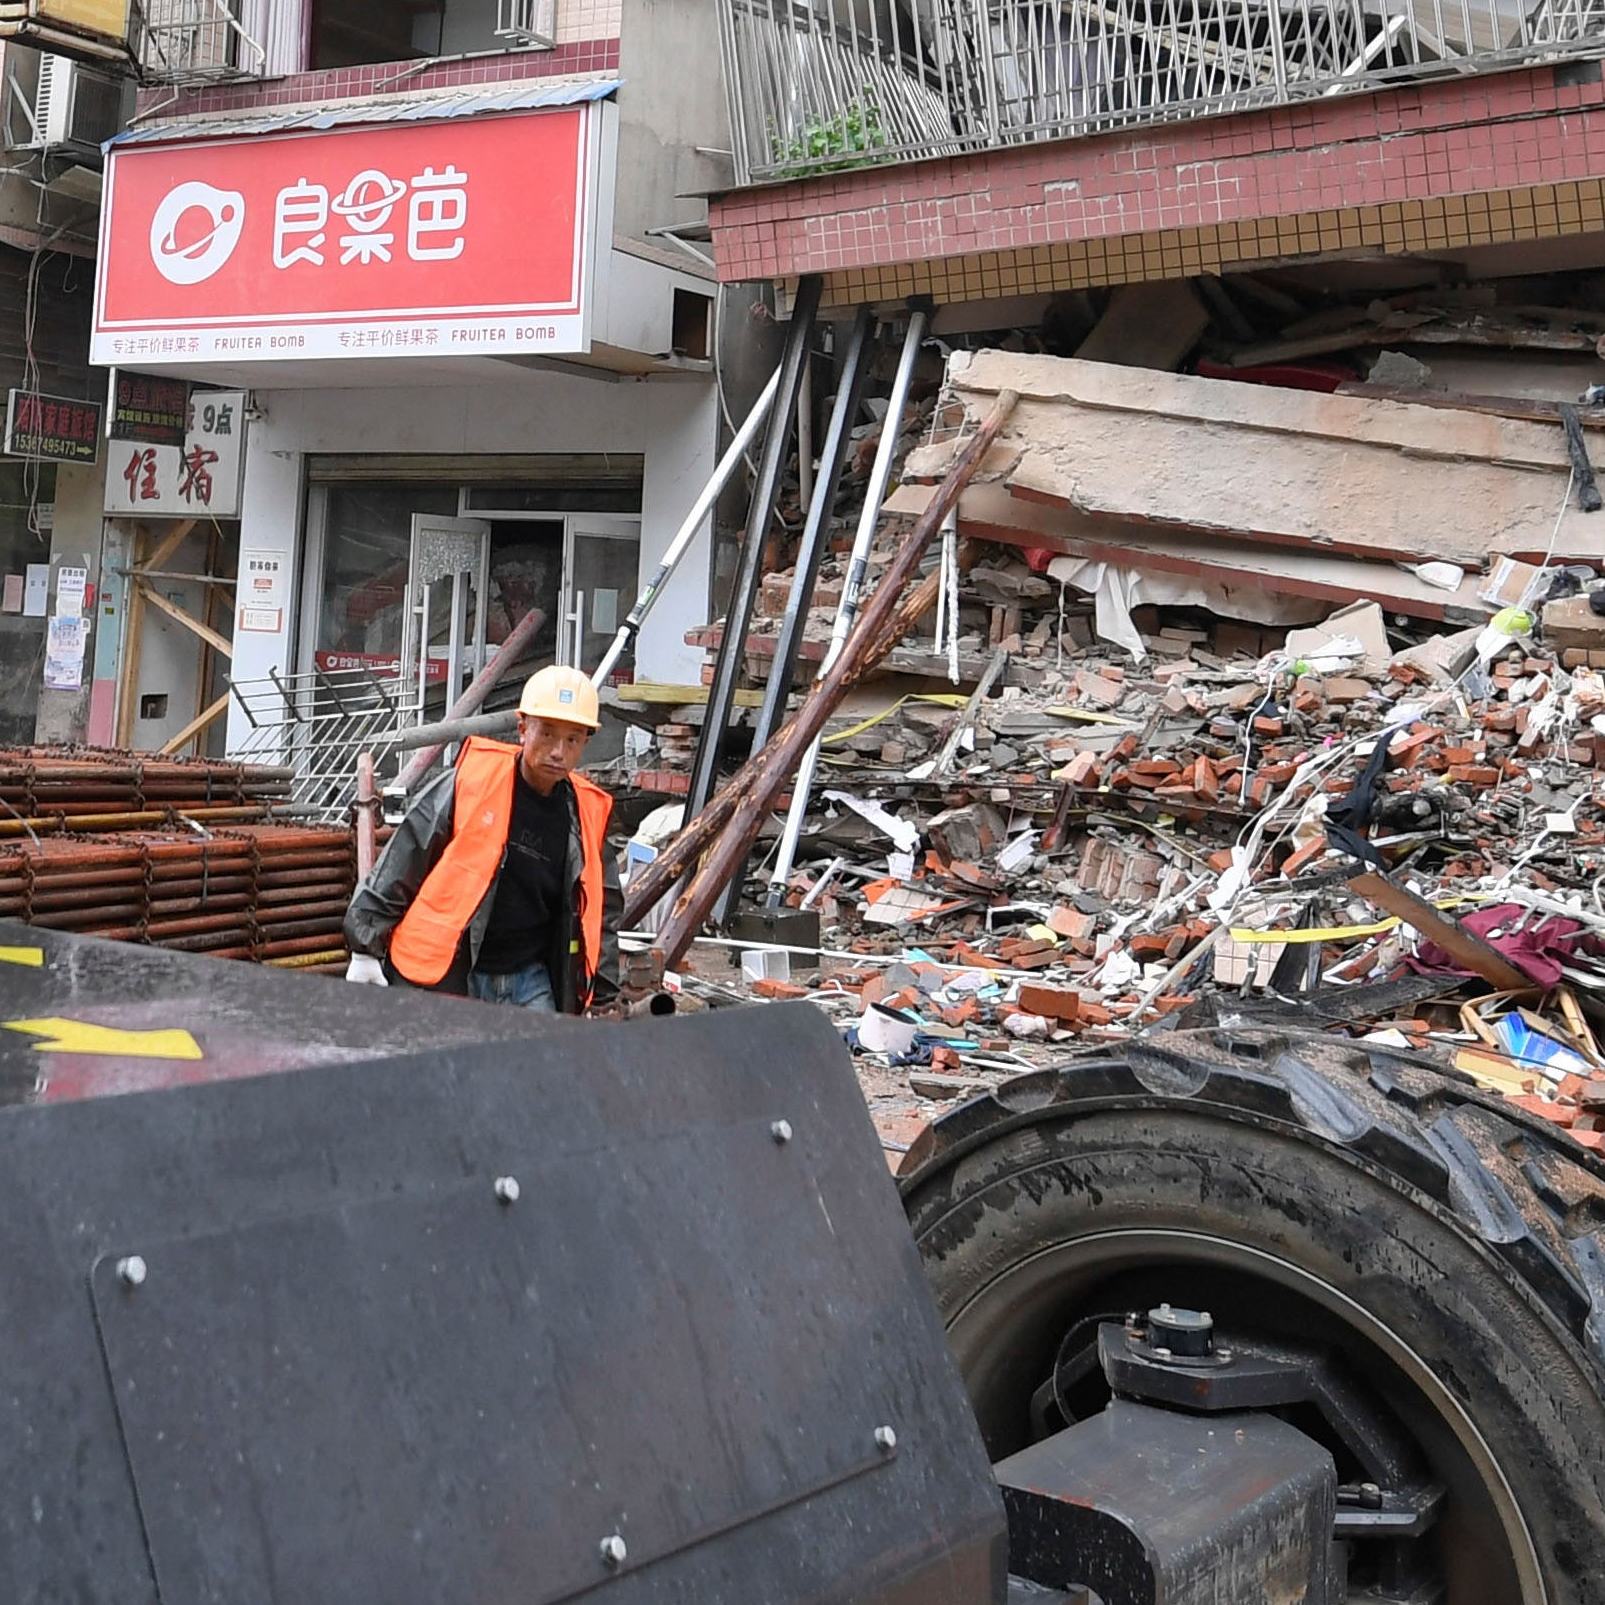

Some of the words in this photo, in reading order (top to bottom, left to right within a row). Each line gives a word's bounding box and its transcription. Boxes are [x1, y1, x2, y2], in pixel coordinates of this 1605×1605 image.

[273, 164, 468, 269] 良果芭
[214, 337, 262, 350] FRUITEA
[270, 335, 305, 348] BOMB
[338, 327, 439, 349] 专注平价鲜果茶
[451, 328, 506, 342] FRUITEA
[516, 326, 556, 340] BOMB
[113, 336, 200, 355] 专注平价鲜果茶
[202, 403, 233, 435] 9点
[124, 443, 219, 507] 住宿
